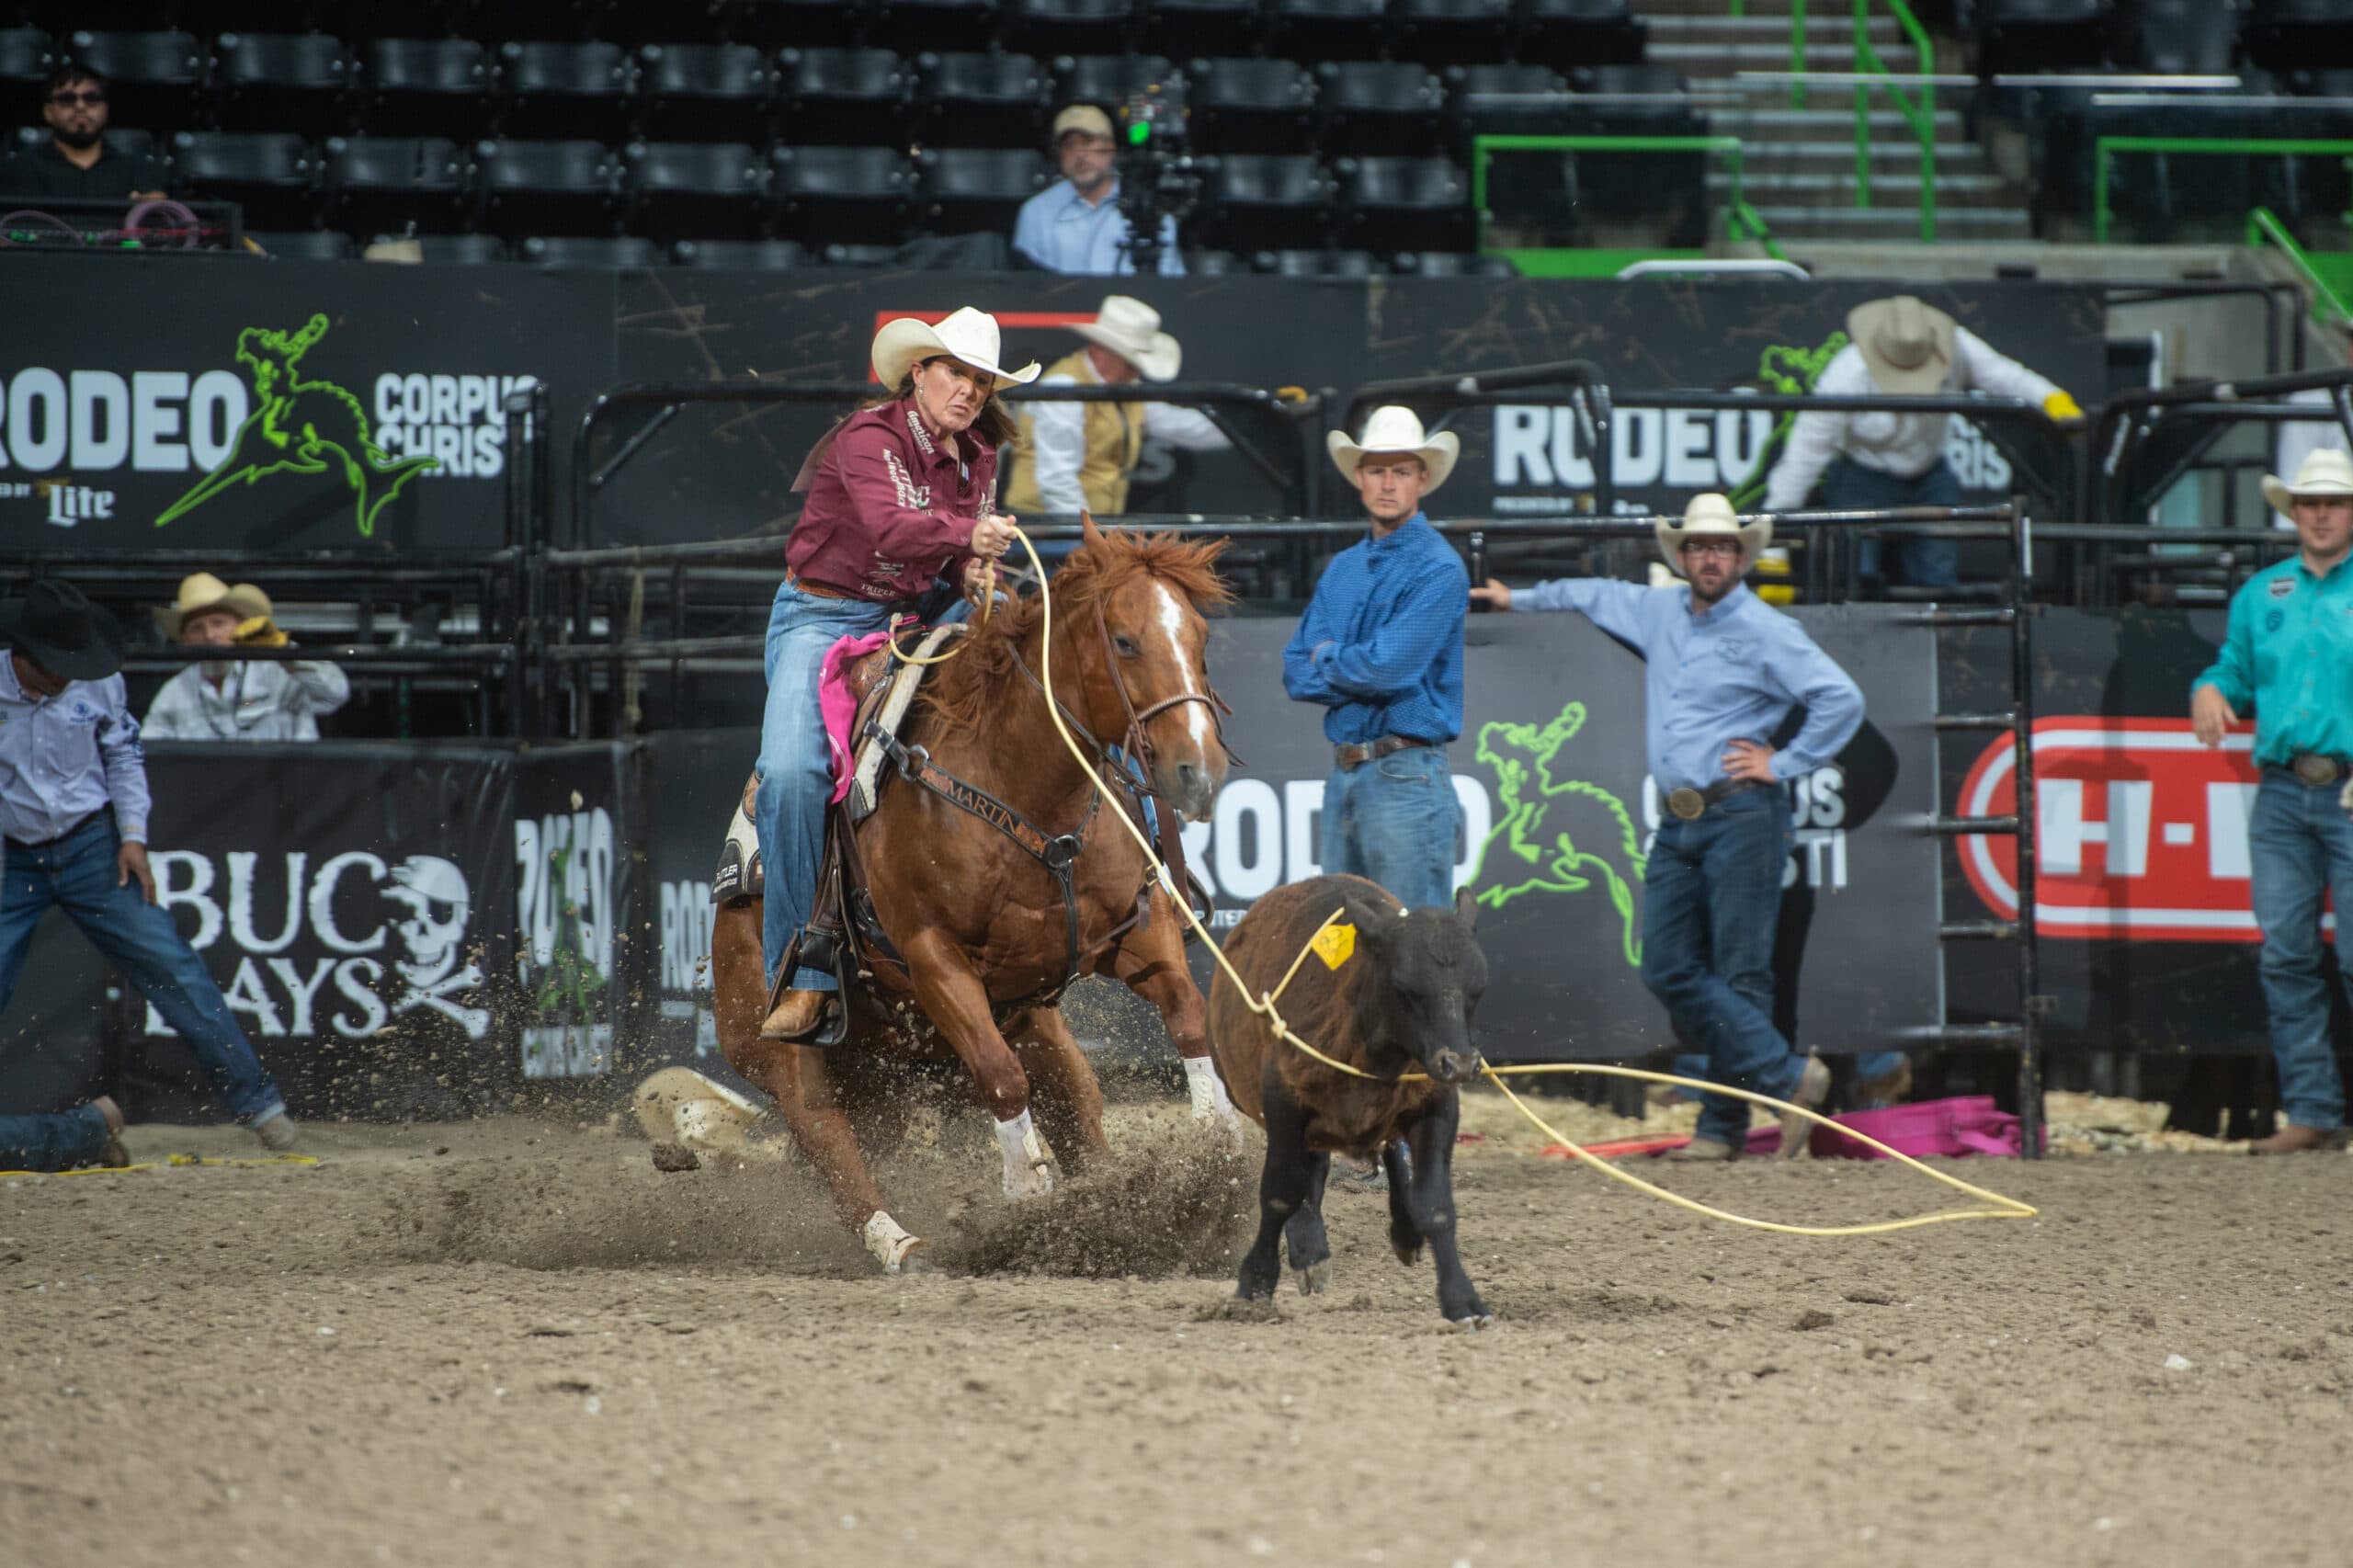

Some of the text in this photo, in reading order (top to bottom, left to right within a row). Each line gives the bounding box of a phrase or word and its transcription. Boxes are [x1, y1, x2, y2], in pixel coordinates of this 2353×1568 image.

[0, 367, 249, 472] ODEO
[47, 483, 116, 528] Lite
[949, 778, 1017, 835] MARTIN
[147, 850, 390, 953] BUC
[143, 957, 389, 1038] AYS
